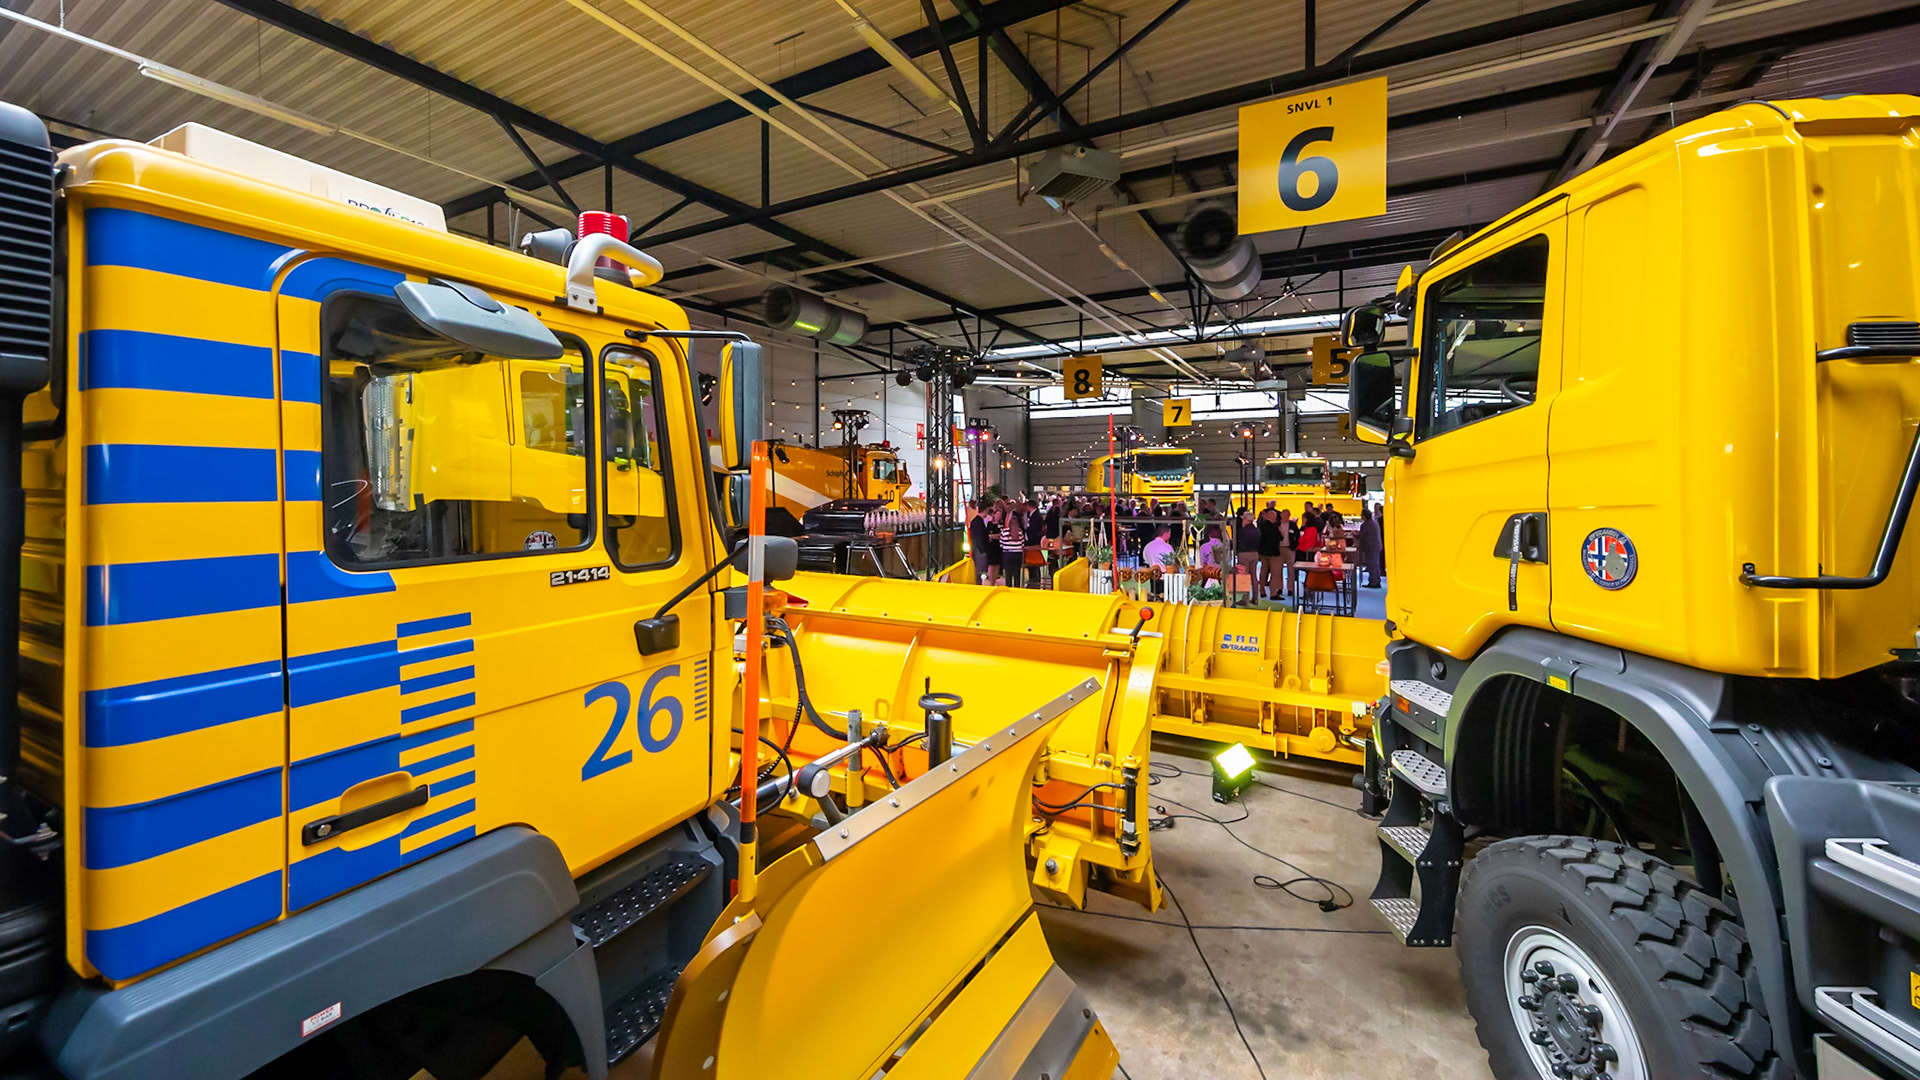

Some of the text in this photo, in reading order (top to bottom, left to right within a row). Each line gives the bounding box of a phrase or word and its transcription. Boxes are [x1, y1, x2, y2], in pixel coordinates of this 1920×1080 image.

[1287, 96, 1332, 114] SNVL 1
[1278, 126, 1339, 212] 6
[1329, 348, 1351, 379] 5
[1074, 369, 1090, 395] 8
[1171, 406, 1183, 423] 7
[581, 664, 684, 782] 26
